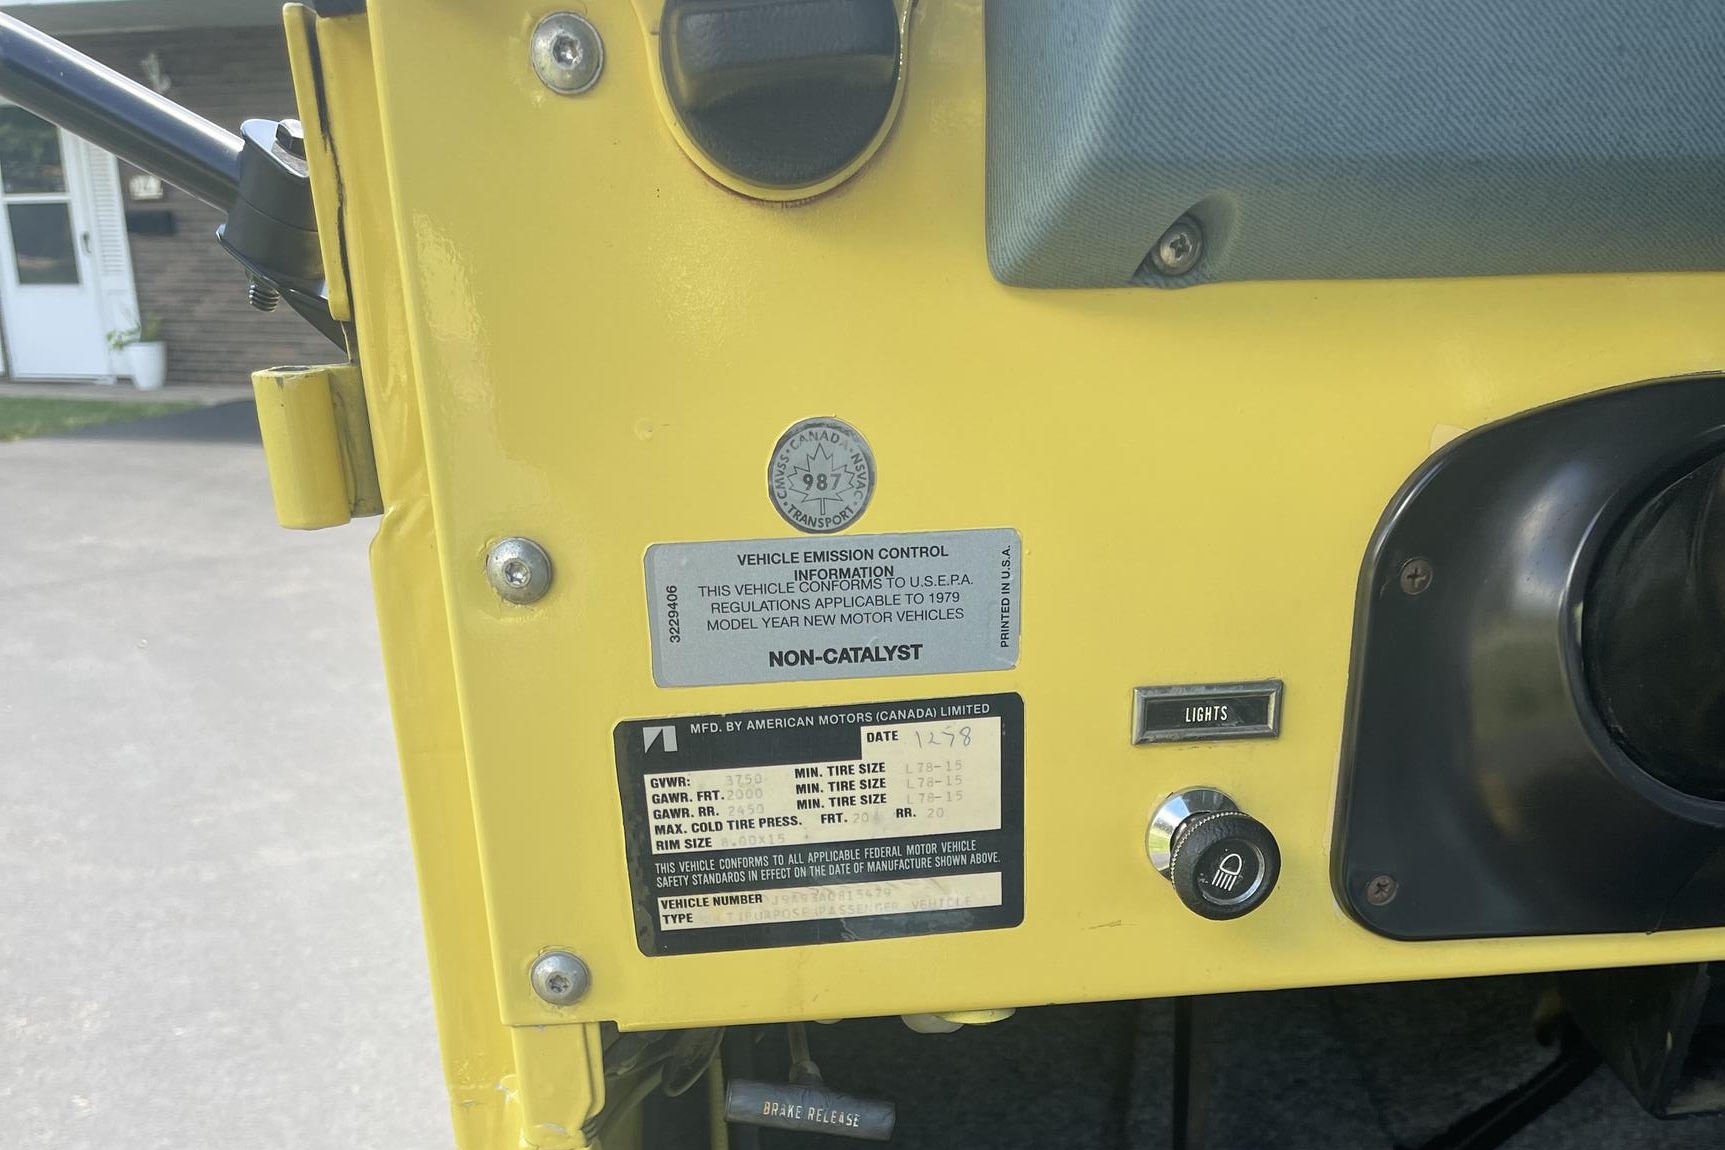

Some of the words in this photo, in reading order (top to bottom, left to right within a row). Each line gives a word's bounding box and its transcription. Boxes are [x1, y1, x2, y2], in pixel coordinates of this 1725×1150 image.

[789, 429, 849, 450] CANADA
[774, 453, 790, 499] CMVSS
[802, 473, 841, 491] 987
[787, 503, 855, 528] TRANSPORT
[737, 552, 800, 566] VEHICLE
[803, 548, 874, 564] EMISSION
[878, 545, 949, 560] CONTROL
[1001, 545, 1011, 579] U.S.A.
[794, 565, 895, 581] INFORMATION
[698, 585, 731, 597] THIS
[734, 582, 795, 596] VEHICLE
[799, 578, 883, 593] CONFORMS
[886, 577, 905, 589] TO
[910, 574, 974, 588] U.S.E.P.A.
[1001, 582, 1010, 595] IN
[711, 598, 811, 614] REGULATIONS
[814, 594, 901, 610] APPLICABLE
[905, 592, 924, 605] TO
[929, 591, 960, 604] 1979
[665, 585, 681, 643] 3229406
[707, 618, 758, 631] MODEL
[762, 616, 800, 629] YEAR
[803, 614, 836, 627] NEW
[840, 611, 893, 625] MOTOR
[896, 607, 965, 622] VEHICLES
[1000, 598, 1010, 648] PRINTED
[769, 643, 923, 668] NON-CATALYST
[690, 723, 722, 734] MFD.
[726, 721, 743, 732] BY
[746, 716, 814, 731] AMERICAN
[818, 712, 873, 725] MOTORS
[875, 707, 937, 723] (CANADA)
[940, 703, 990, 717] LIMITED
[1185, 705, 1228, 722] LIGHTS
[866, 730, 899, 743] DATE
[794, 766, 823, 779] MIN.
[827, 764, 855, 777] TIRE
[858, 762, 886, 774] SIZE
[905, 759, 964, 774] L78-15
[650, 777, 691, 789] GVWR:
[725, 772, 763, 786] 3750
[795, 782, 824, 795] MIN.
[828, 779, 856, 793] TIRE
[859, 777, 887, 790] SIZE
[906, 774, 963, 789] L78-15
[652, 792, 693, 805] GAWR.
[696, 789, 725, 802] FRT.
[726, 787, 763, 801] 2000
[796, 797, 825, 810] MIN.
[829, 795, 857, 808] TIRE
[860, 793, 888, 806] SIZE
[653, 807, 695, 820] GAWR.
[698, 806, 720, 818] RR.
[727, 803, 765, 817] 2450
[820, 812, 848, 825] FRT.
[895, 807, 917, 819] RR.
[926, 807, 945, 819] 20
[654, 823, 688, 836] MAX.
[691, 820, 723, 834] COLD
[726, 818, 755, 831] TIRE
[758, 815, 803, 828] PRESS.
[656, 838, 681, 852] RIM
[684, 836, 713, 849] SIZE
[655, 862, 676, 875] THIS
[679, 859, 716, 874] VEHICLE
[719, 855, 769, 871] CONFORMS
[772, 854, 785, 867] TO
[788, 852, 804, 866] ALL
[808, 848, 861, 864] APPLICABLE
[864, 844, 903, 860] FEDERAL
[906, 842, 938, 856] MOTOR
[941, 839, 977, 854] VEHICLE
[656, 874, 690, 889] SAFETY
[692, 870, 746, 886] STANDARDS
[748, 869, 758, 882] IN
[761, 867, 791, 881] EFFECT
[794, 866, 807, 878] ON
[809, 864, 826, 877] THE
[828, 862, 851, 876] DATE
[853, 861, 865, 874] OF
[867, 856, 933, 873] MANUFACTURE
[934, 854, 968, 868] SHOWN
[969, 851, 1001, 865] ABOVE.
[660, 896, 710, 910] VEHICLE
[712, 893, 763, 907] NUMBER
[662, 913, 694, 925] TYPE
[762, 1101, 802, 1119] BRAKE
[807, 1106, 861, 1128] RELEASE
